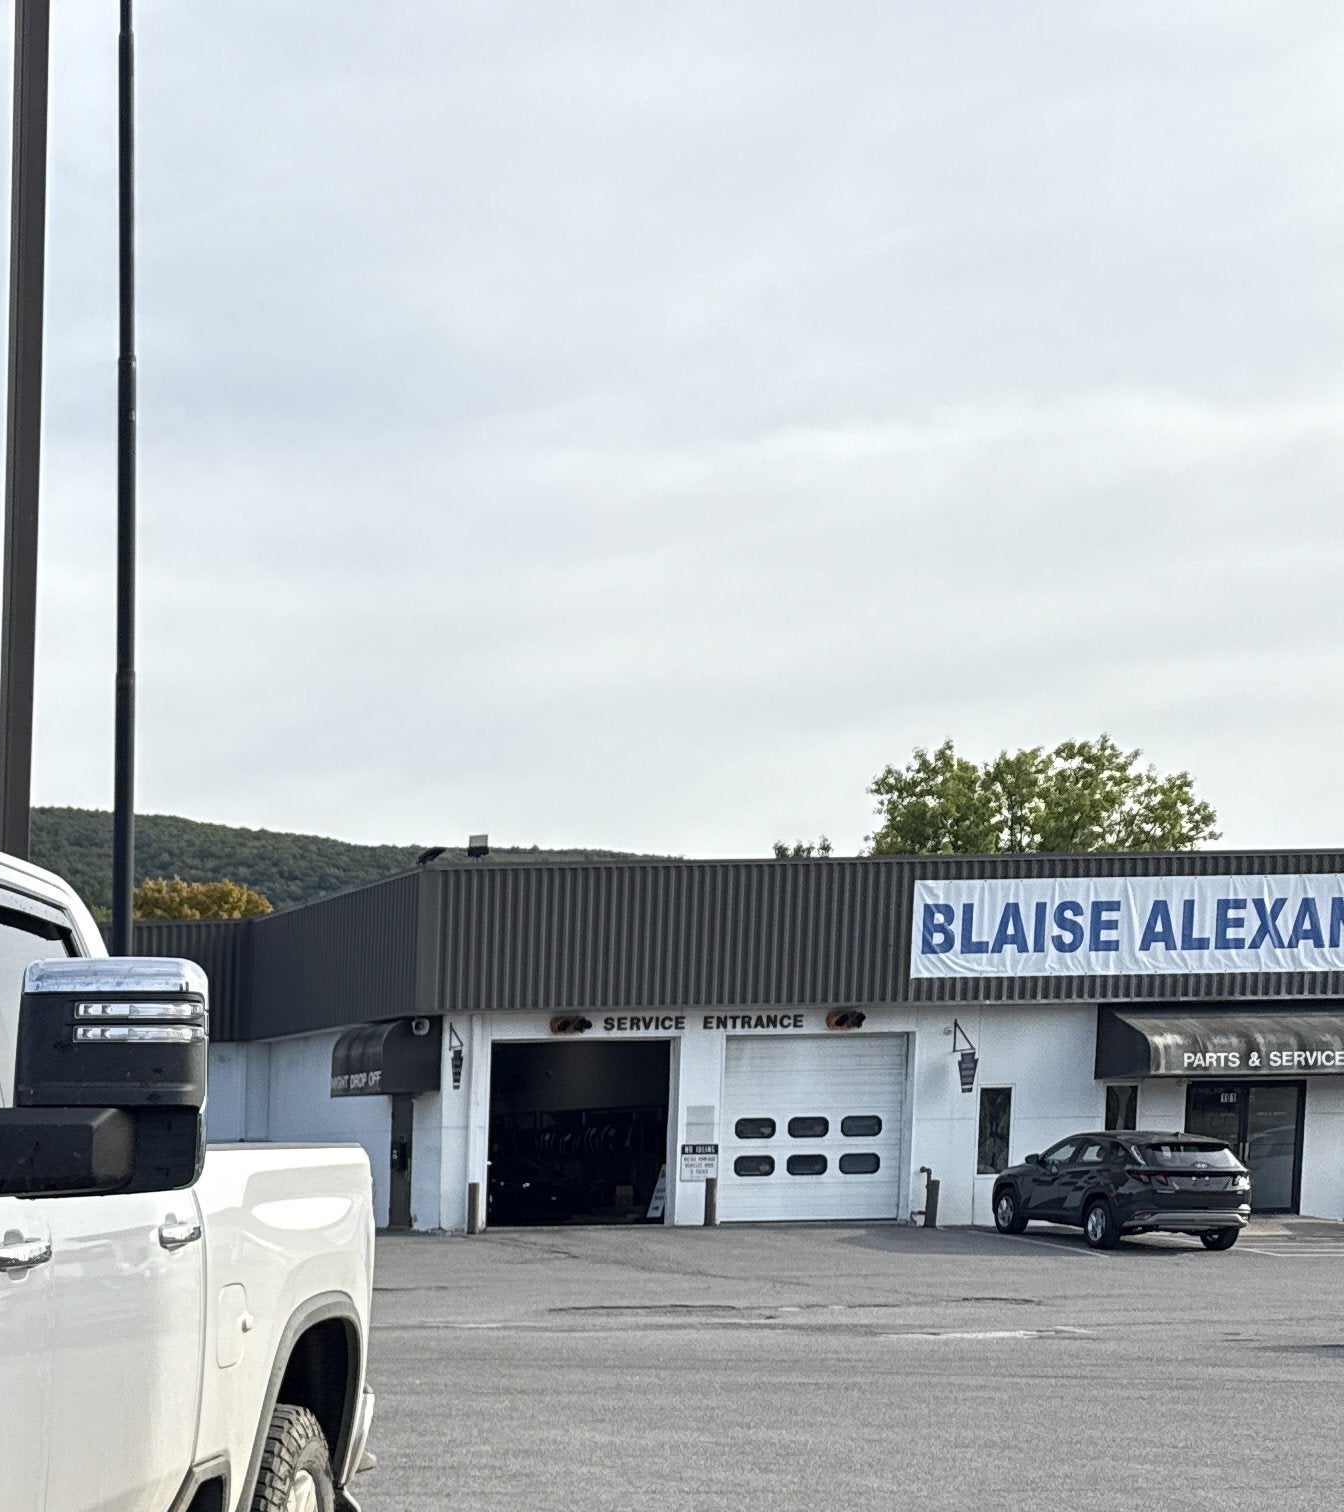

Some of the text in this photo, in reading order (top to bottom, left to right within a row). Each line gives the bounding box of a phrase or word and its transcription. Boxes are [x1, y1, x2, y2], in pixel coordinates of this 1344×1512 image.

[921, 900, 1122, 954] BLAISE
[603, 1014, 804, 1031] SERVICE ENTRANCE
[1183, 1050, 1344, 1067] PARTS & SERVICE
[350, 1072, 367, 1089] DROP
